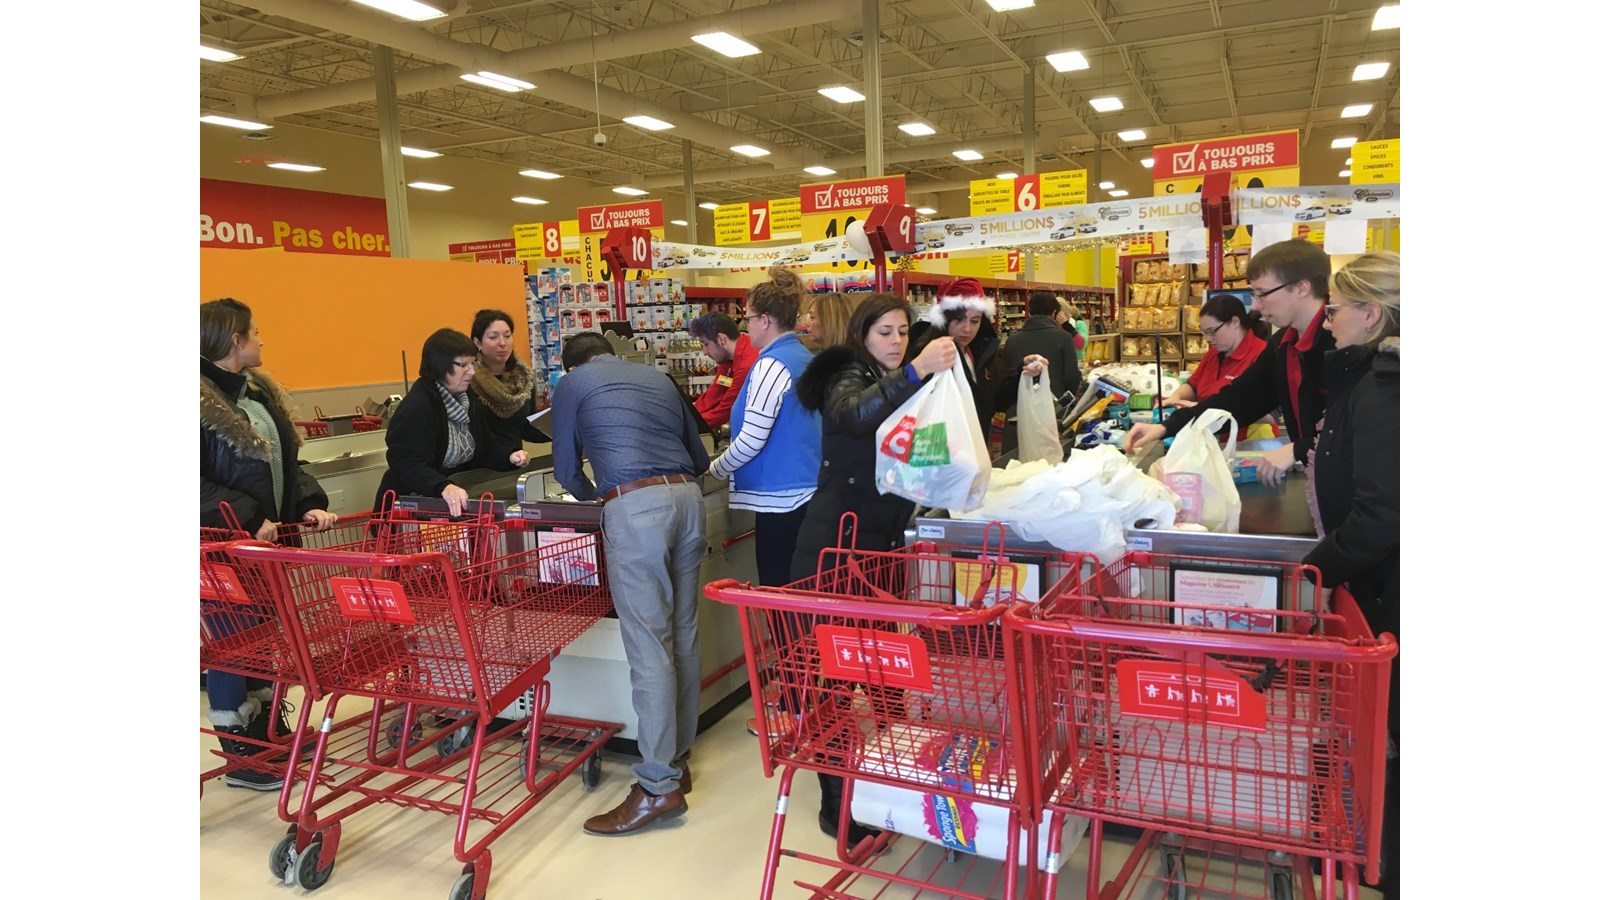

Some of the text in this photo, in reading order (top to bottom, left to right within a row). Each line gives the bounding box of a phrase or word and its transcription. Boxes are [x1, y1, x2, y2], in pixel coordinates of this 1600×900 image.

[1203, 142, 1275, 159] TOUJOURS
[1197, 154, 1275, 171] À BAS PRIX
[837, 185, 888, 198] TOUJOURS
[1018, 182, 1036, 211] 6
[834, 195, 888, 208] À BAS PRIX
[1139, 202, 1201, 218] 5 MILLIO
[608, 209, 650, 220] TOUJOURS
[614, 220, 629, 228] BAS
[632, 218, 650, 226] PRIX
[752, 208, 767, 234] 7
[200, 214, 390, 252] Bon. Pas cher.
[900, 215, 910, 244] 9
[981, 224, 988, 234] 5
[546, 228, 558, 252] 8
[631, 236, 646, 262] 10
[1010, 256, 1018, 270] 7
[889, 431, 911, 455] C
[951, 806, 961, 829] ECONO
